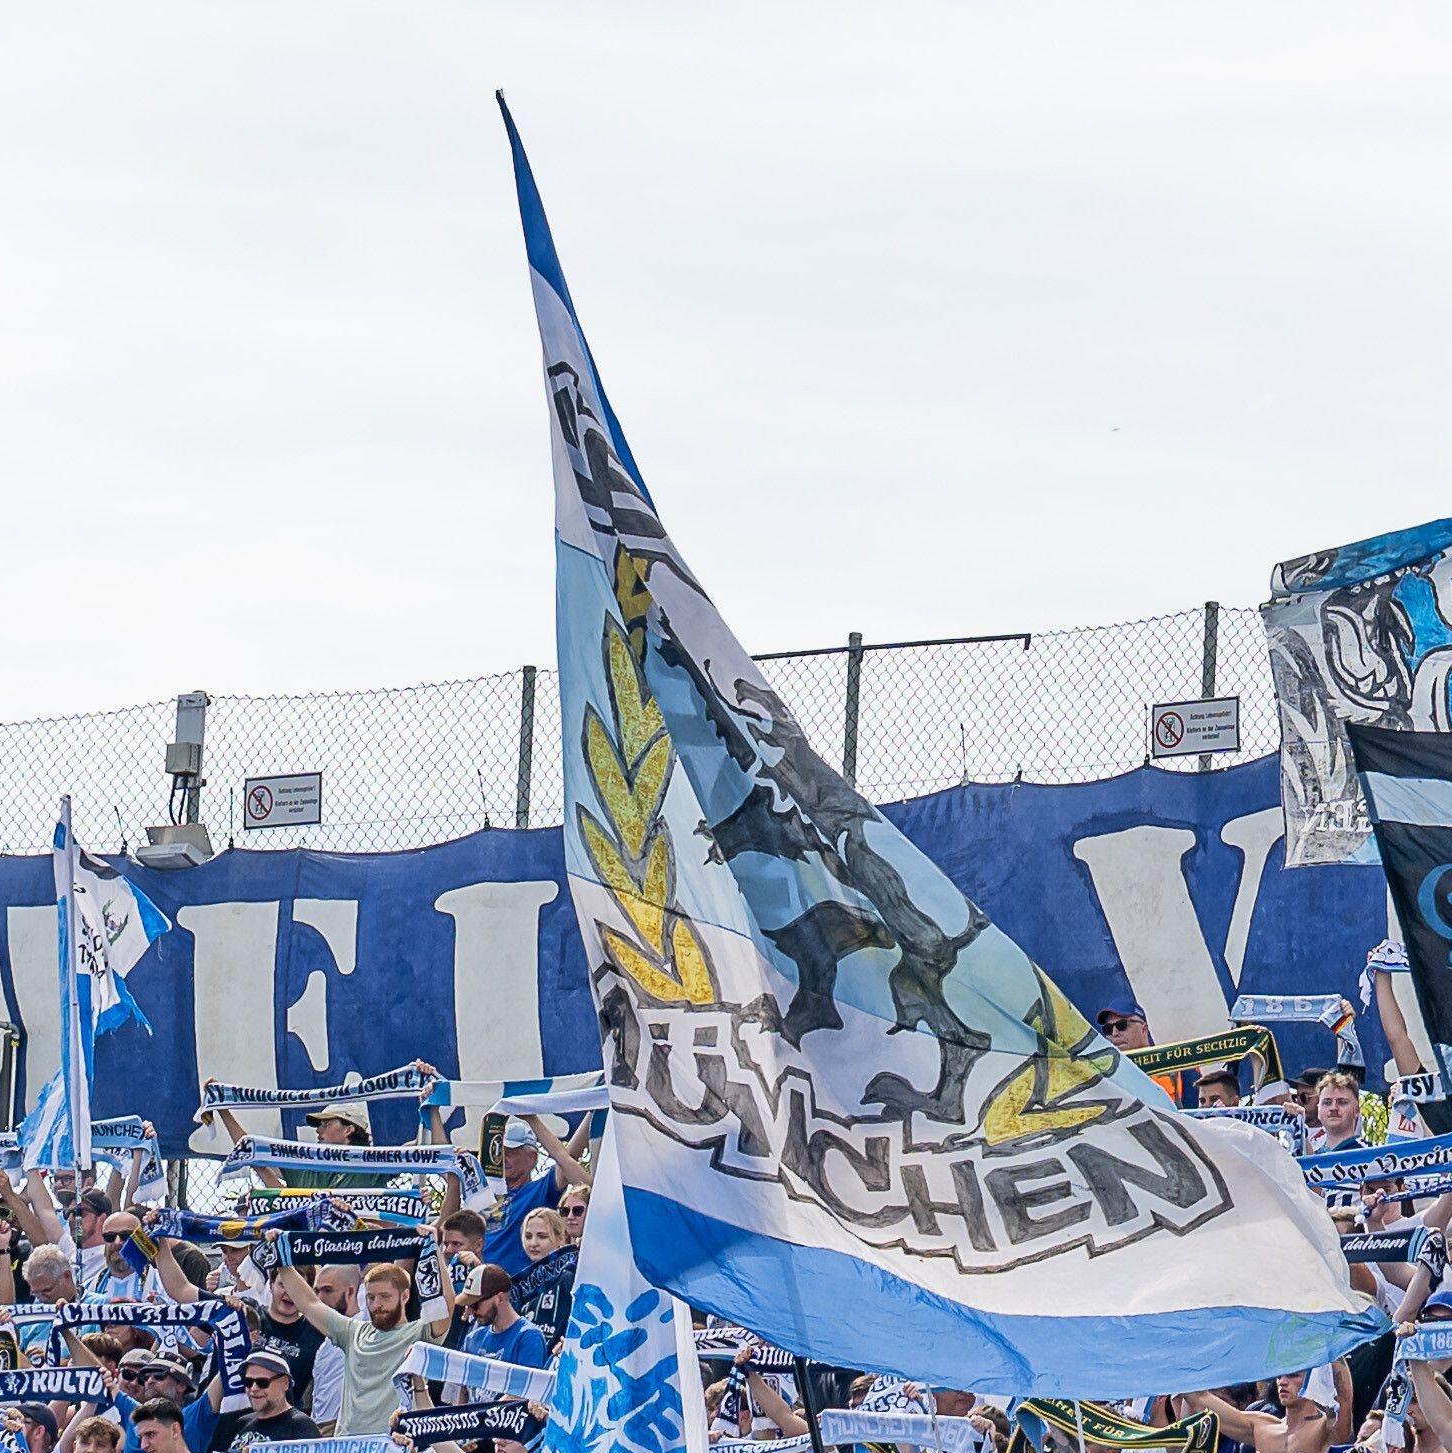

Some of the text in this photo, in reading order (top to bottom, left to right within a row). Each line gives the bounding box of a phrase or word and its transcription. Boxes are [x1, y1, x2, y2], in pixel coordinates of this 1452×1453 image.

[1165, 1036, 1248, 1062] FÜR SECHZIG
[1401, 1076, 1435, 1097] TSV
[270, 1143, 442, 1165] EINMAL LÖWE IMMER LÖWE
[292, 1234, 424, 1255] In Giasing dahoam
[217, 1311, 245, 1391] BLAU
[484, 1404, 528, 1434] Stolz
